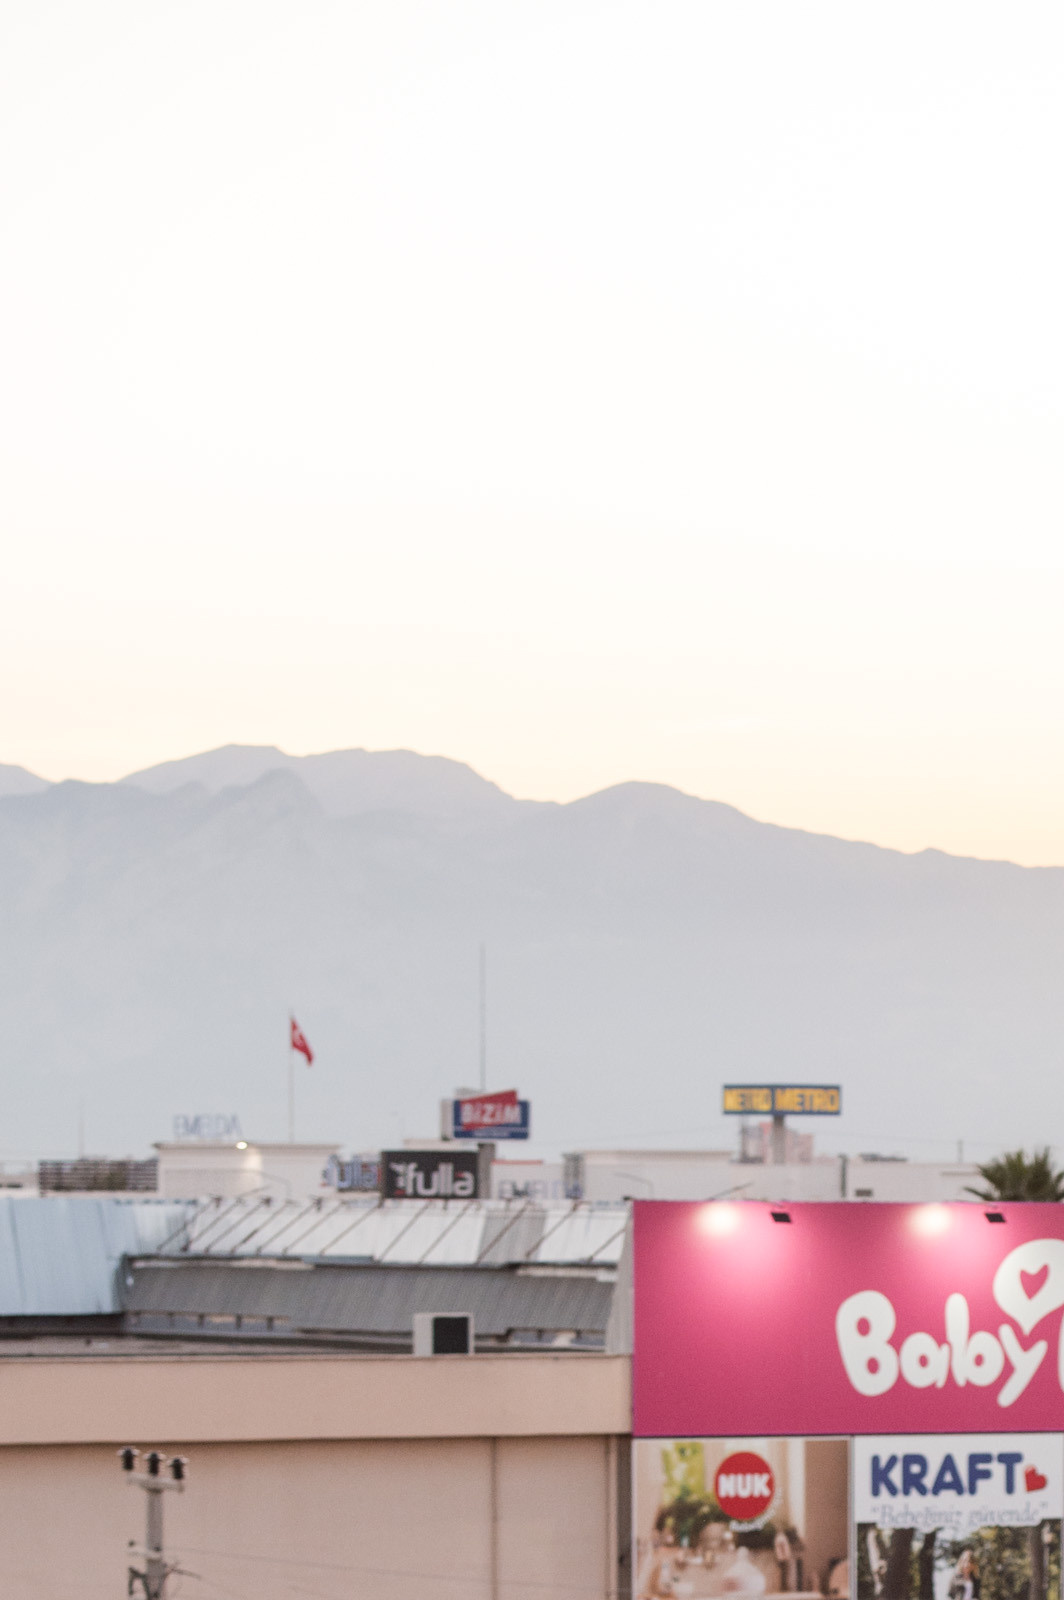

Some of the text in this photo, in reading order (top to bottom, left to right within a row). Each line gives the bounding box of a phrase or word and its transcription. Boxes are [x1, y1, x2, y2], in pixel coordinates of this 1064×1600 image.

[404, 1162, 475, 1197] fulla
[836, 1290, 1048, 1408] Baby
[718, 1473, 771, 1498] NUK
[871, 1453, 1023, 1497] KRAFT
